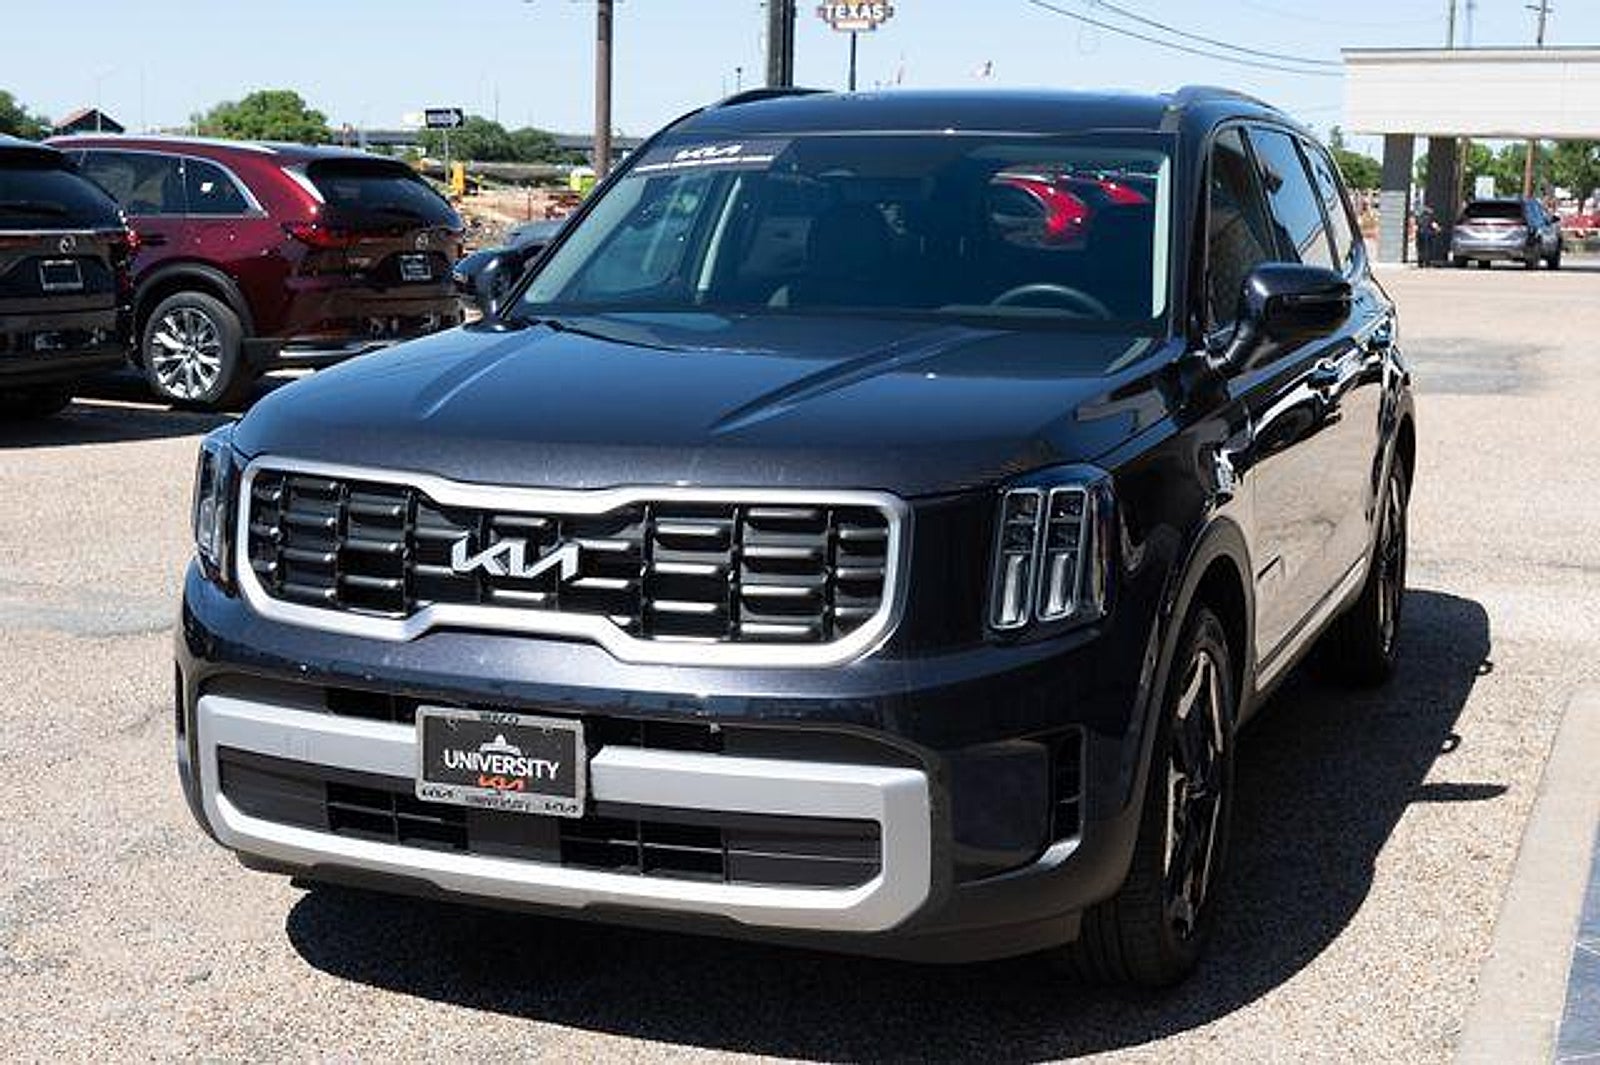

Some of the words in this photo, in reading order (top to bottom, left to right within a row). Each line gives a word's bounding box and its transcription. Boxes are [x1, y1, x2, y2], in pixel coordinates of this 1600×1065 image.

[825, 4, 886, 20] TEXAS
[452, 538, 579, 581] KIA
[444, 748, 559, 781] UNIVERSITY
